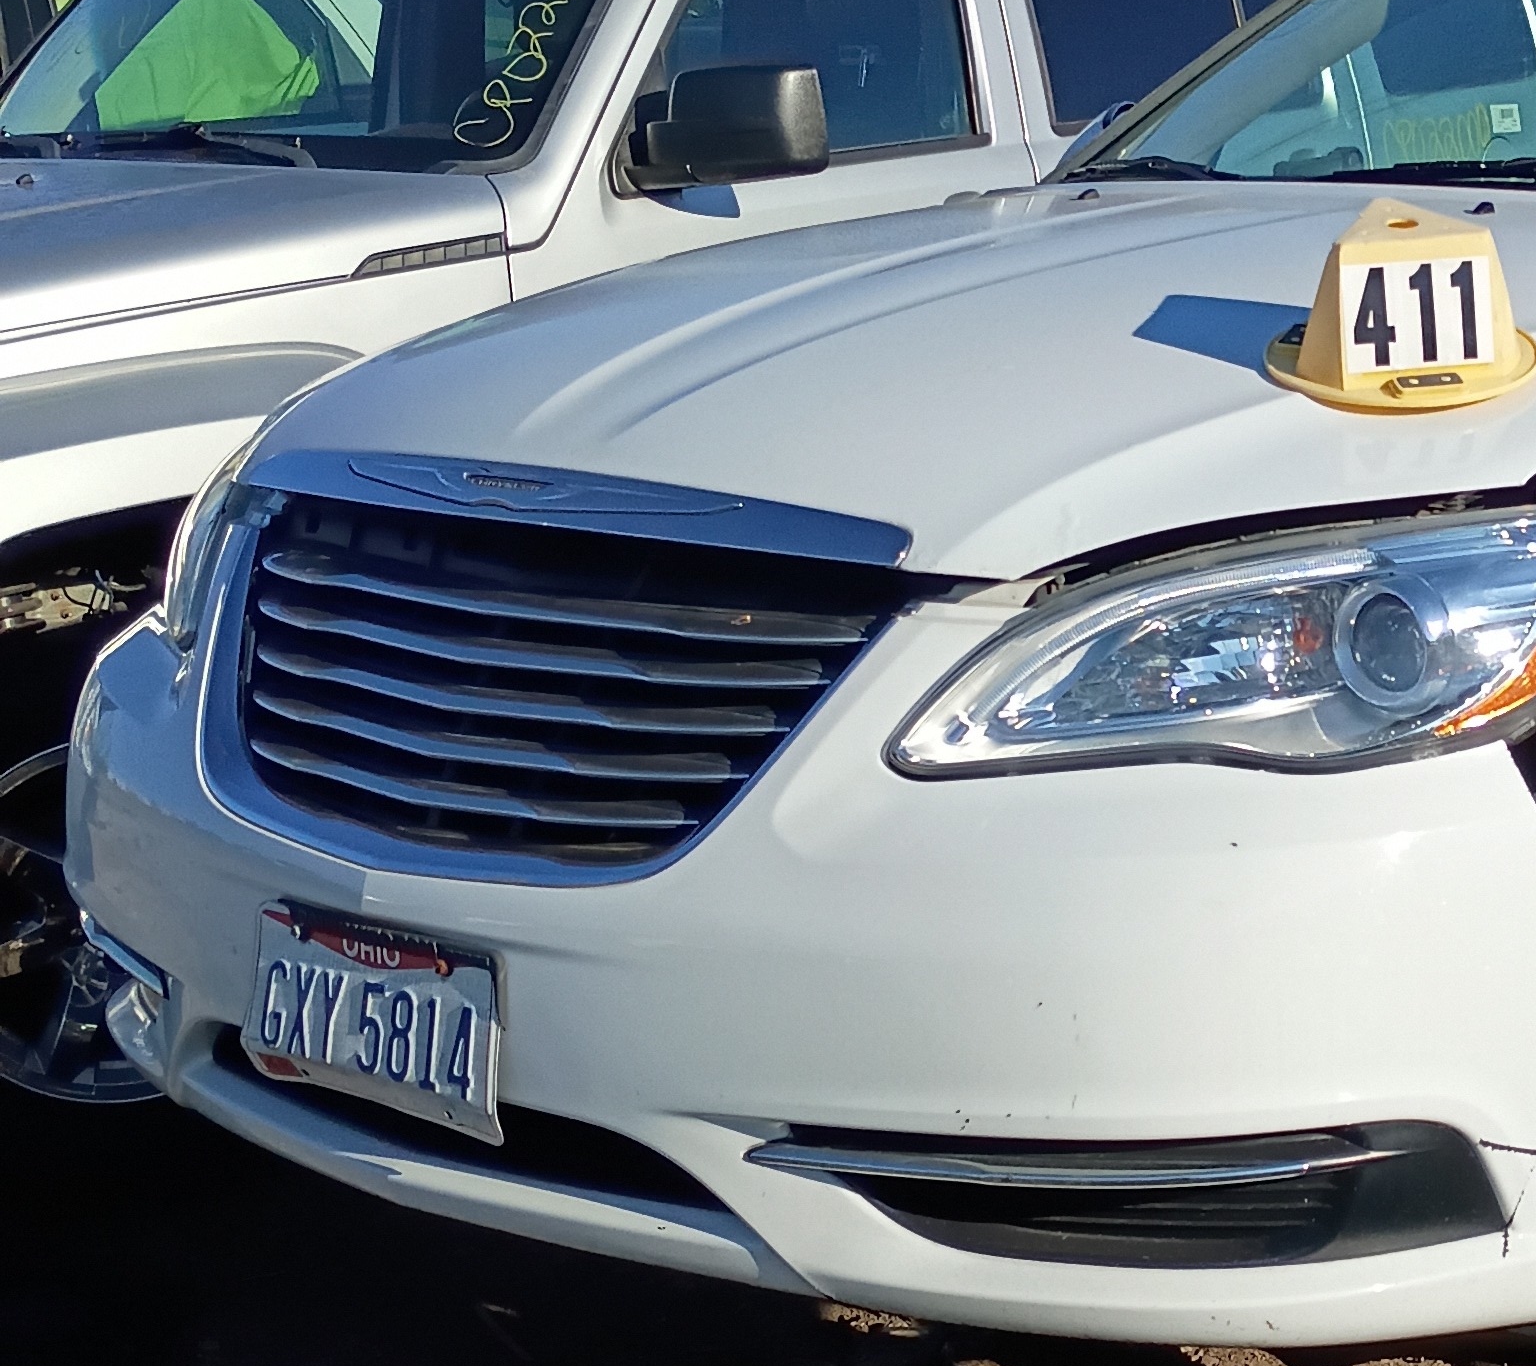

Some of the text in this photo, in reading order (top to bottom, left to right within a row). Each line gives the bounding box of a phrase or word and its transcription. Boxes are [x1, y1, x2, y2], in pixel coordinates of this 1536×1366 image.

[1353, 260, 1478, 367] 411
[260, 958, 478, 1102] GXY 5814
